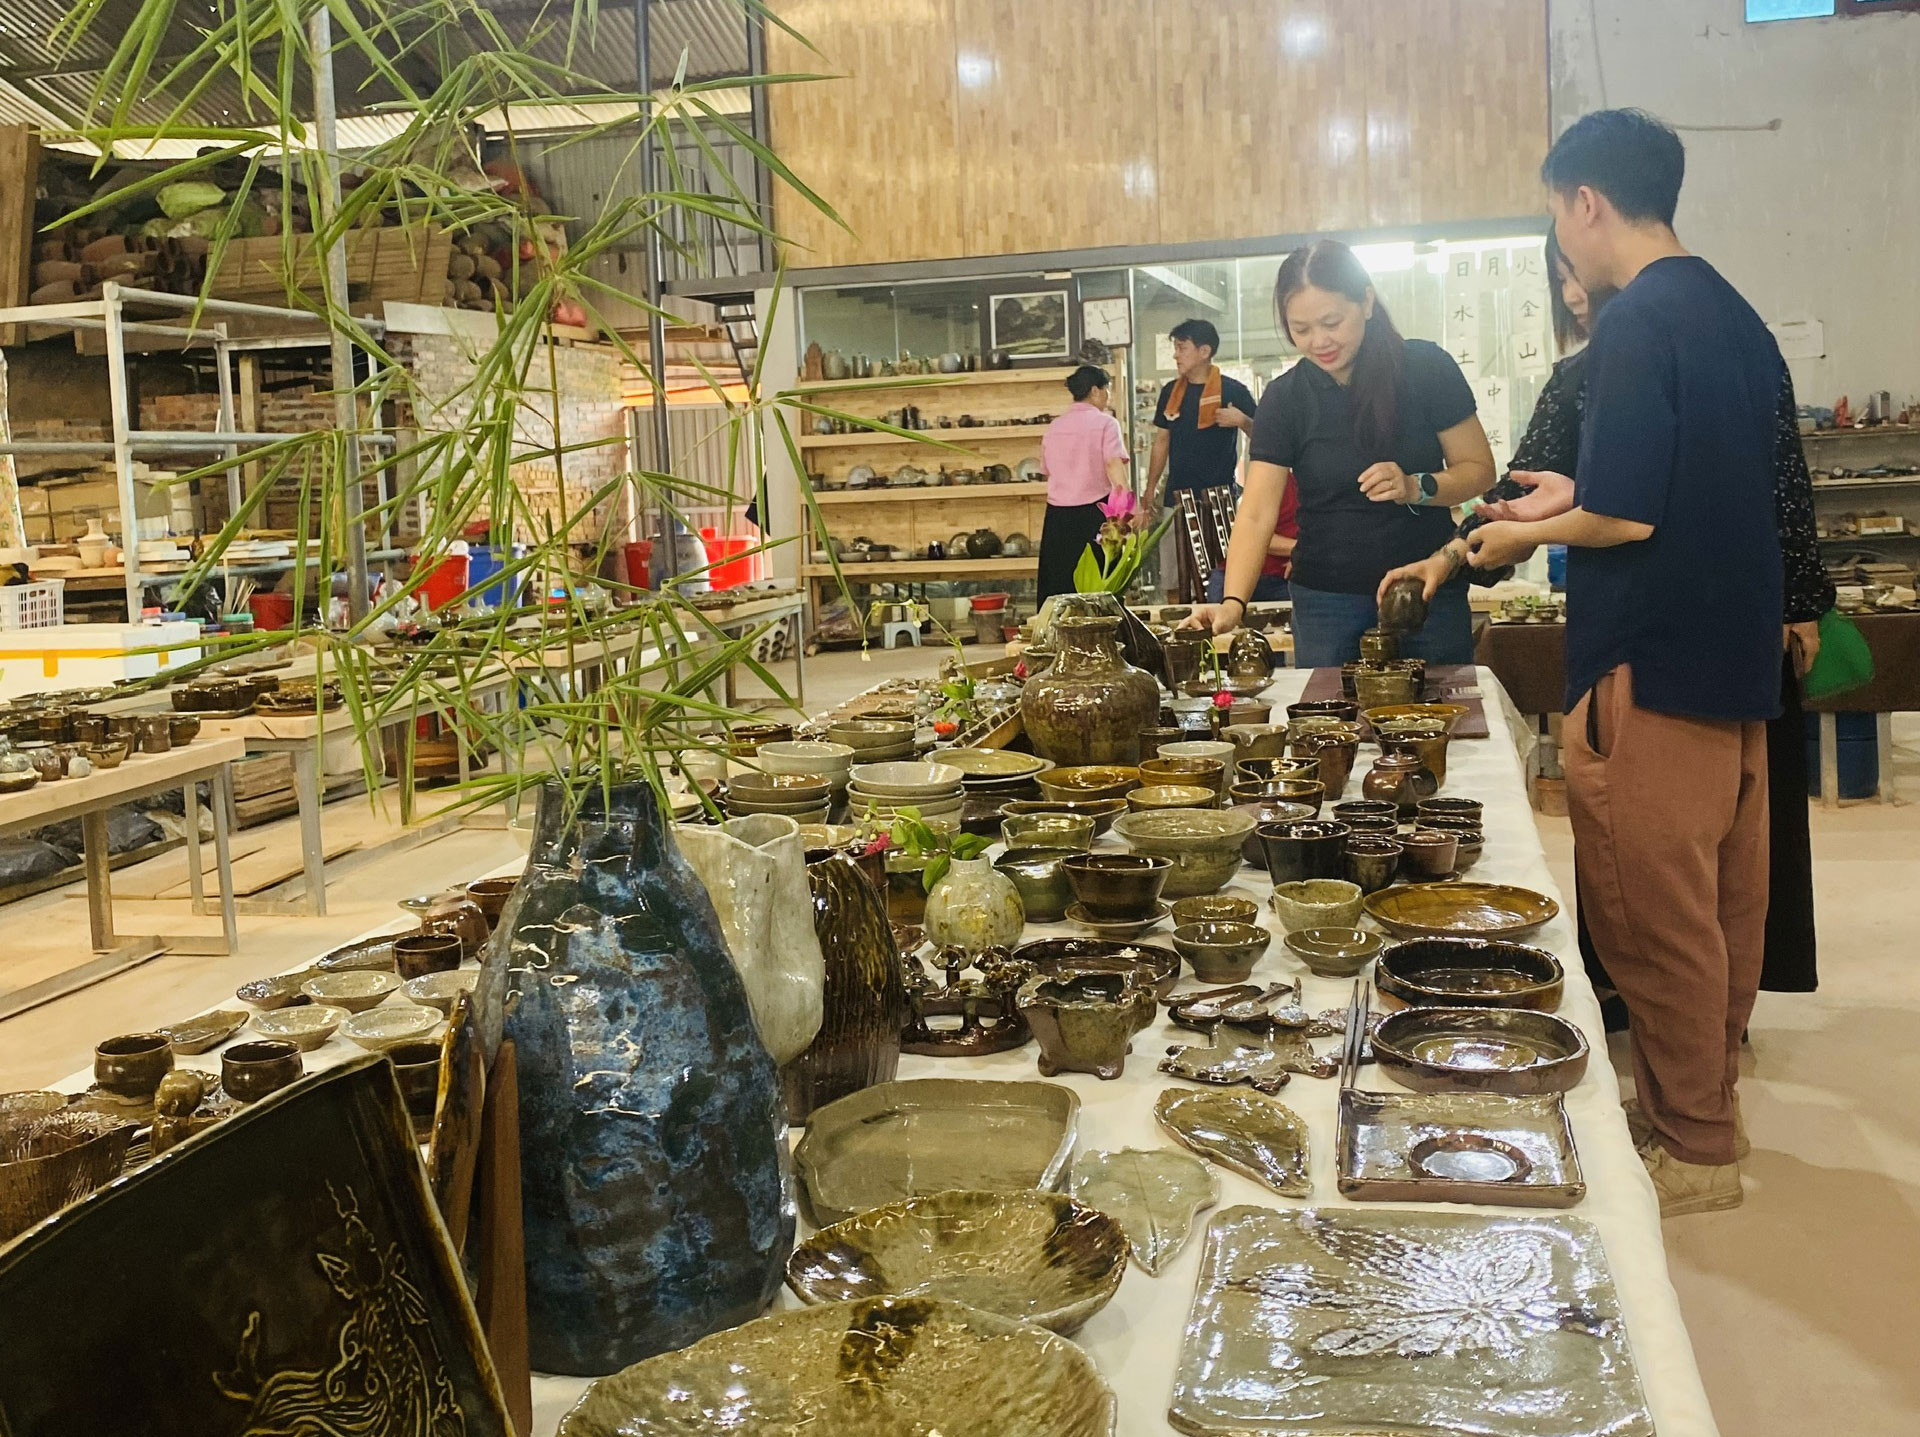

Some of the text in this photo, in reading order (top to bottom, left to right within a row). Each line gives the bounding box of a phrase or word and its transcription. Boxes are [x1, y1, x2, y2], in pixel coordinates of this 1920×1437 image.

[1457, 261, 1470, 277] 日
[1488, 256, 1499, 276] 月
[1516, 255, 1538, 277] 火
[1453, 305, 1474, 322] 水
[1520, 300, 1540, 318] 金
[1458, 349, 1475, 365] 土
[1519, 342, 1537, 359] 山
[1487, 382, 1501, 405] 中
